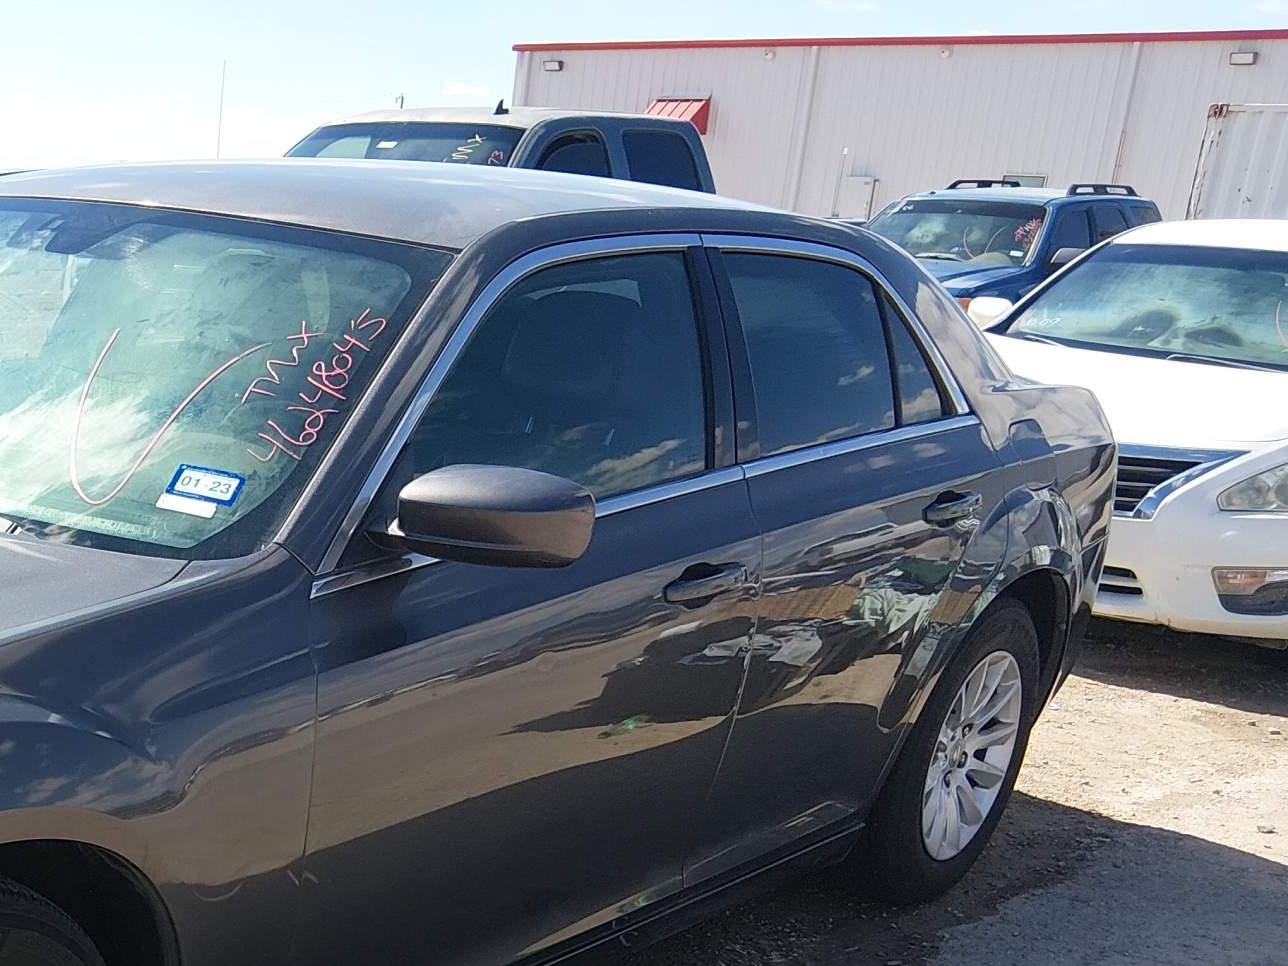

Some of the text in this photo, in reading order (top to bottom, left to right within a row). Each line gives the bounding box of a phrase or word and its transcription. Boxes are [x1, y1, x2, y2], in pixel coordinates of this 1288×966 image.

[247, 308, 387, 461] 46248045
[180, 475, 232, 495] 01 23
